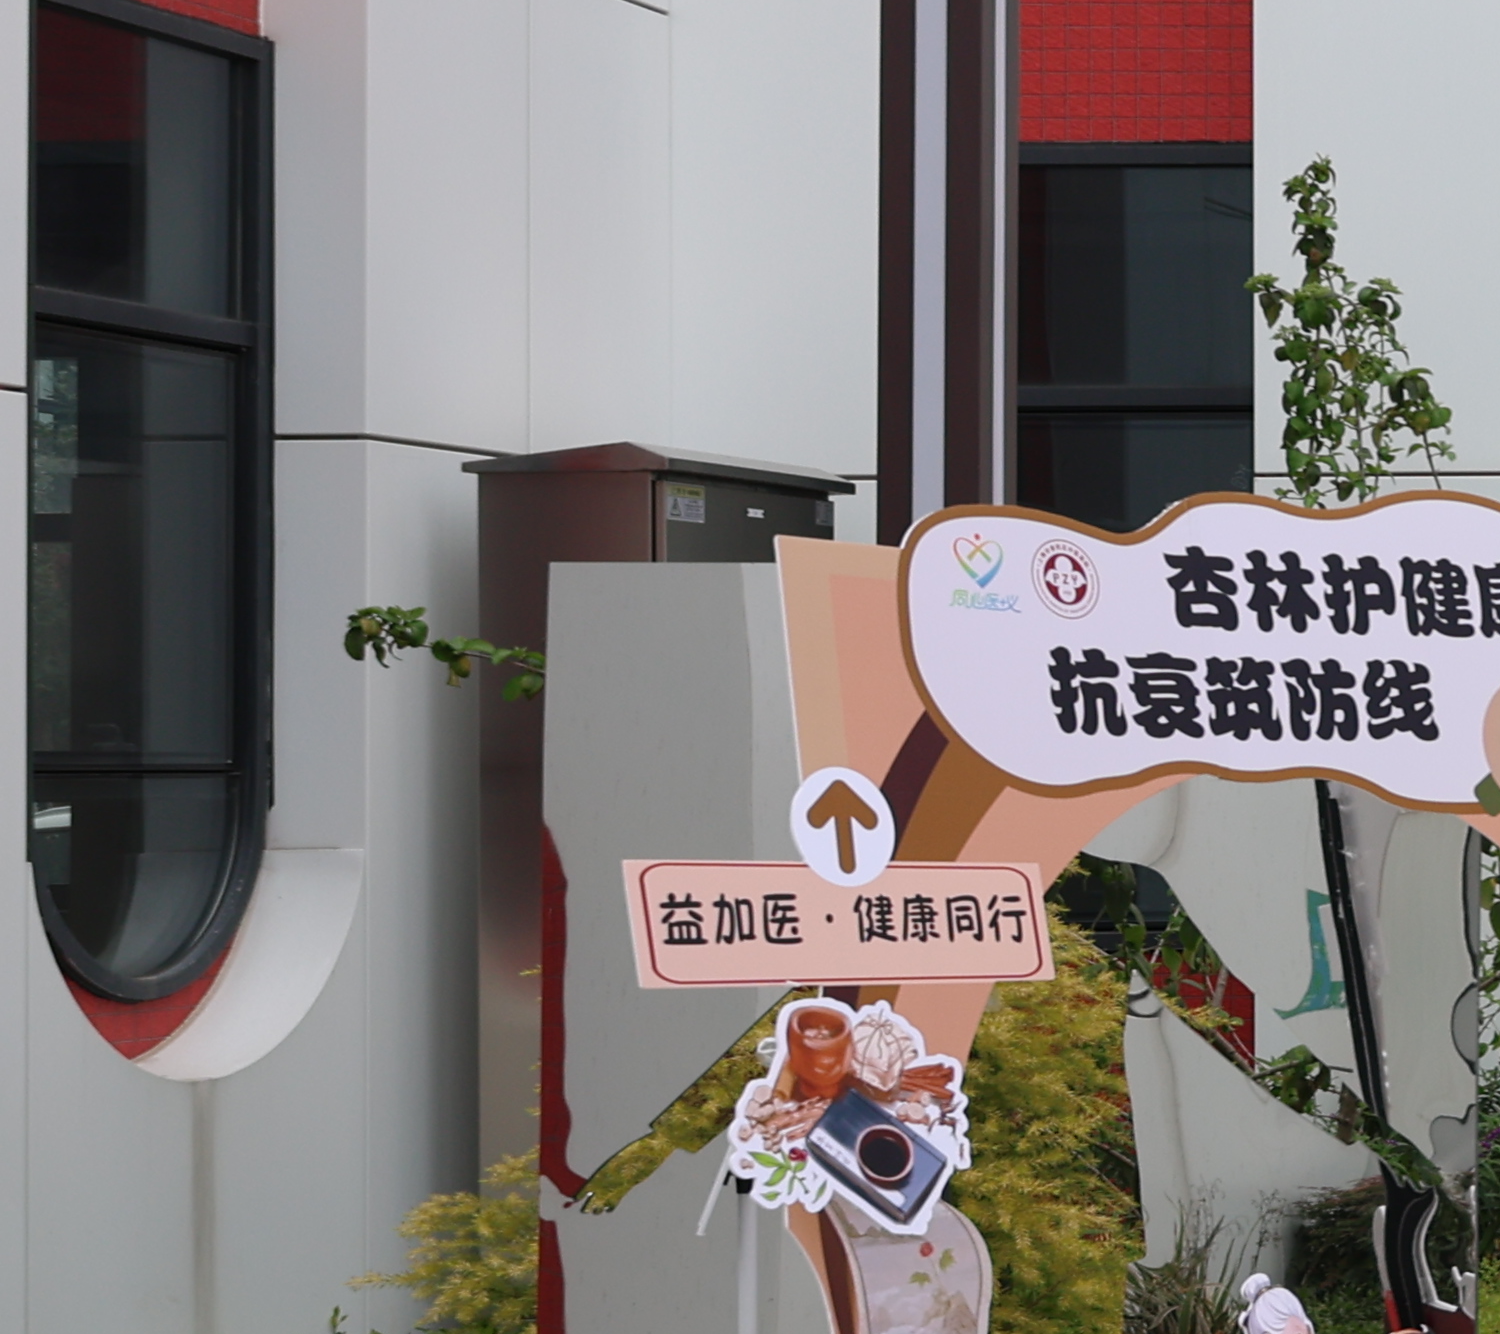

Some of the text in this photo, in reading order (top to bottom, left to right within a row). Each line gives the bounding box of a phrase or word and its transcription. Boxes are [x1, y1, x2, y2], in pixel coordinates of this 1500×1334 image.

[1048, 647, 1440, 742] 抗衰筑防线
